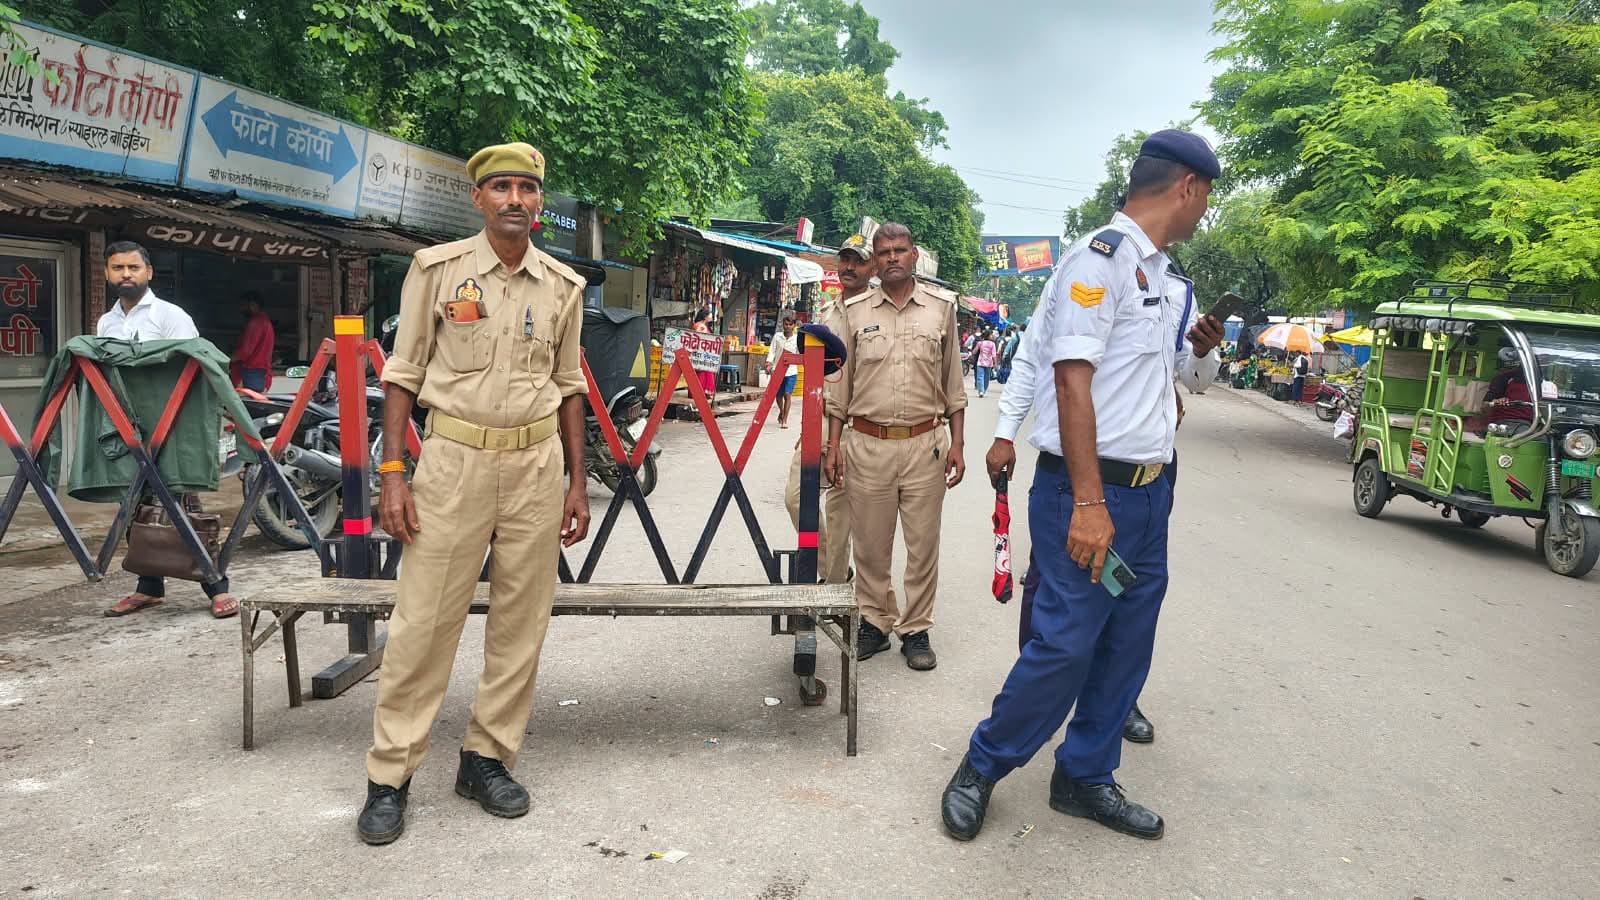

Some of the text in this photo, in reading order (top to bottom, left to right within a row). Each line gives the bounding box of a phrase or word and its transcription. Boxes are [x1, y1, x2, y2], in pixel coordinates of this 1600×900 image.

[119, 72, 183, 131] कॉपी
[286, 124, 335, 162] कॉपी
[425, 171, 448, 187] जन
